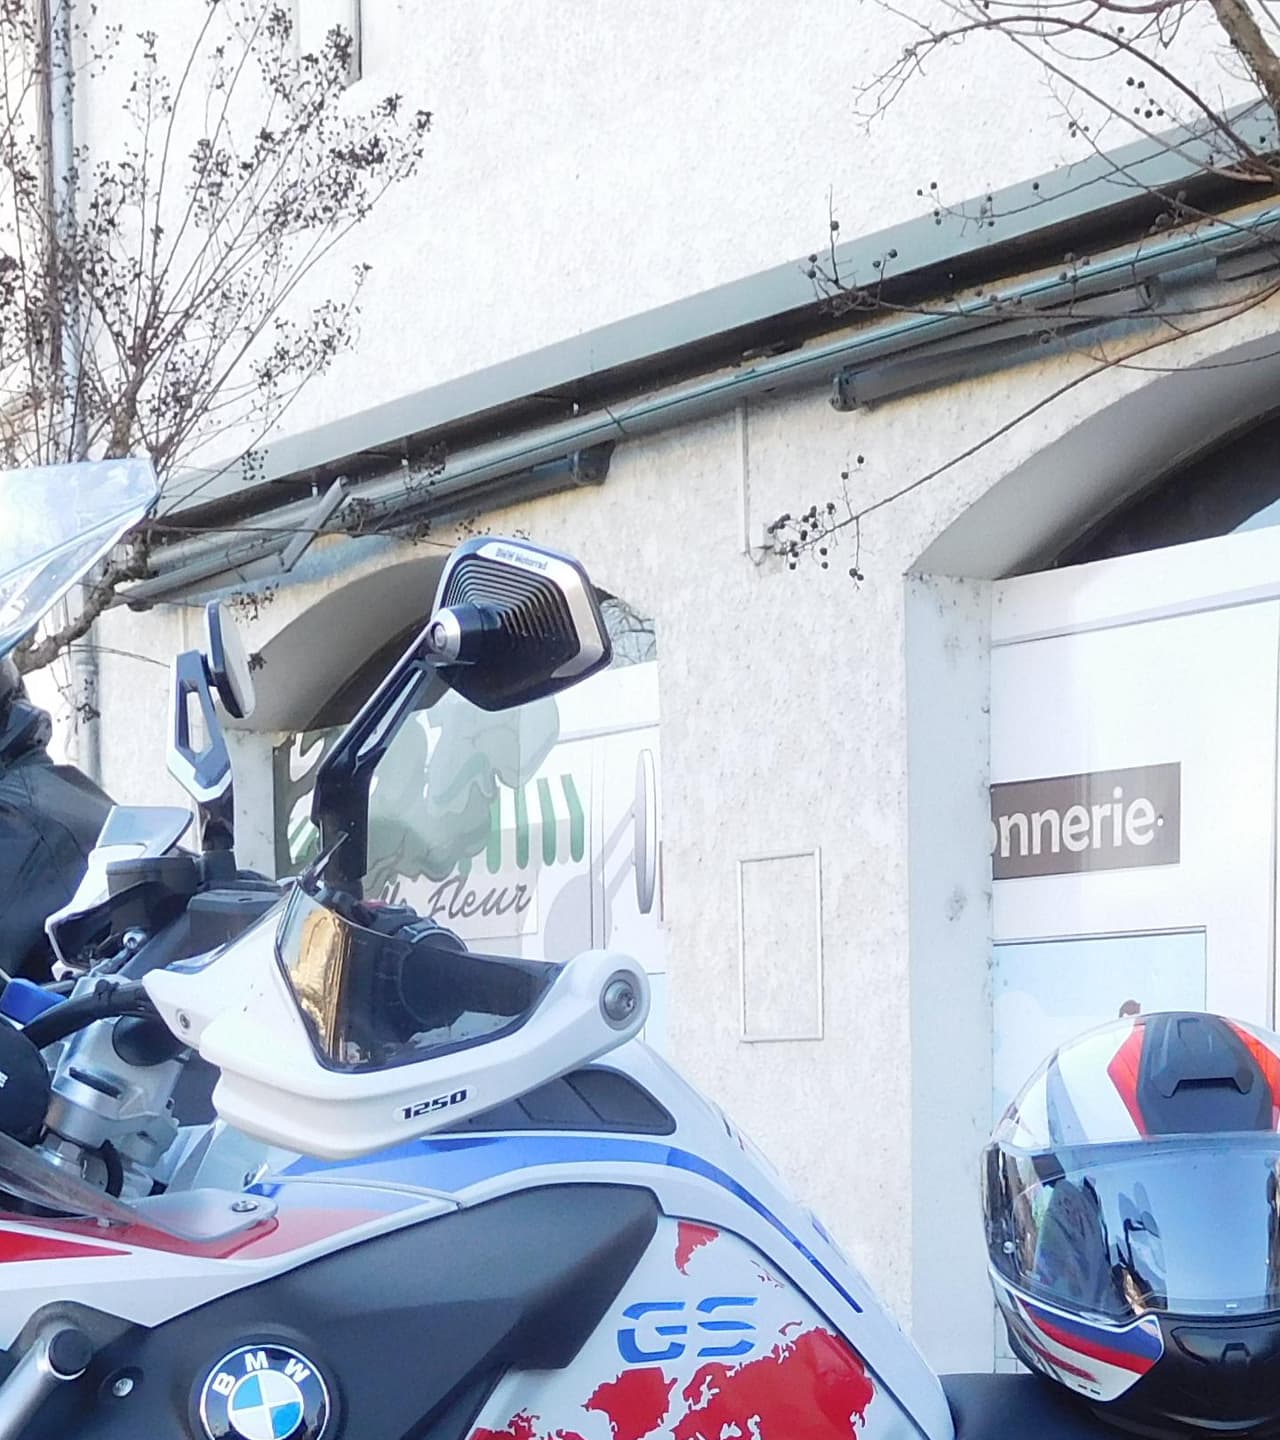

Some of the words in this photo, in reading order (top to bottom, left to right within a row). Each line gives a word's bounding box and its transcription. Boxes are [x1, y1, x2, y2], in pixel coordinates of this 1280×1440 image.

[428, 874, 532, 920] Fleur
[402, 1089, 468, 1120] 1250
[616, 1296, 759, 1364] GS
[212, 1350, 312, 1398] BMW
